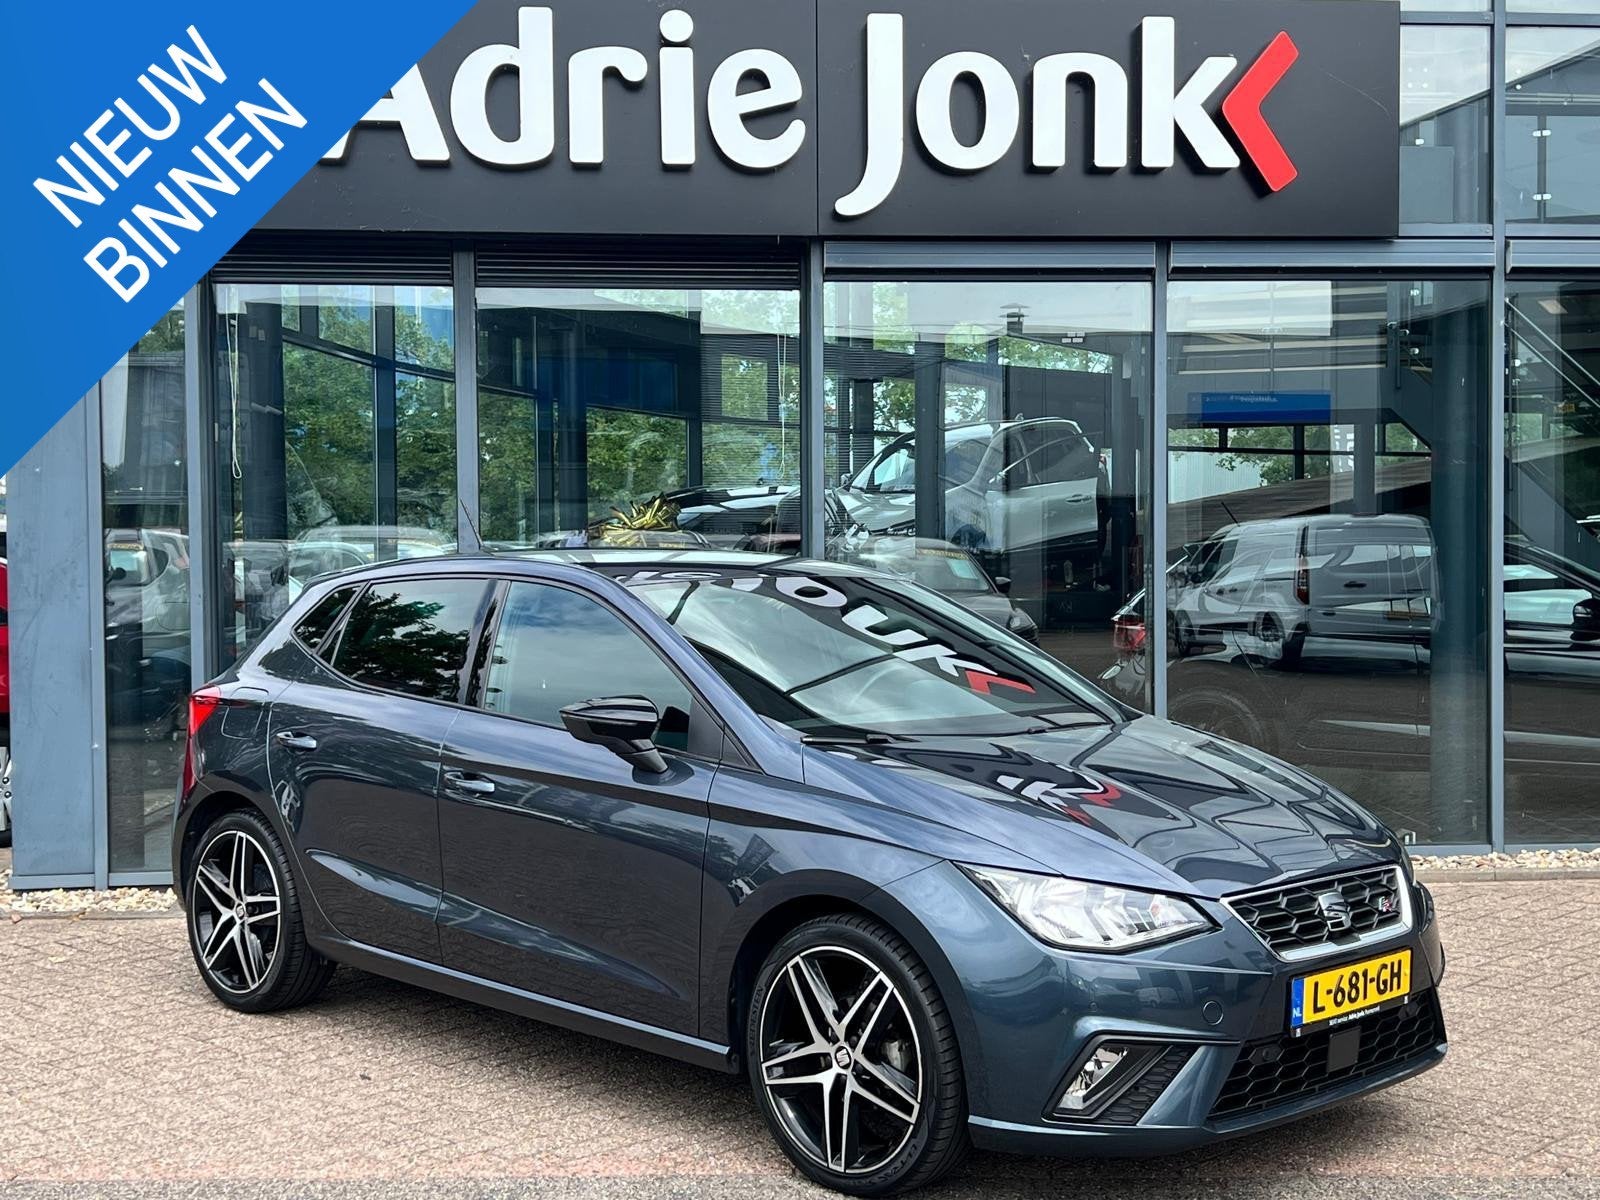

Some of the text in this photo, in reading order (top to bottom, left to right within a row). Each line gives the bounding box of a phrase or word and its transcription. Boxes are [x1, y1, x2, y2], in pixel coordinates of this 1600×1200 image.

[318, 6, 1241, 217] Adrie Jonk
[1292, 1006, 1303, 1019] NL
[1312, 959, 1402, 1014] L-681-GH
